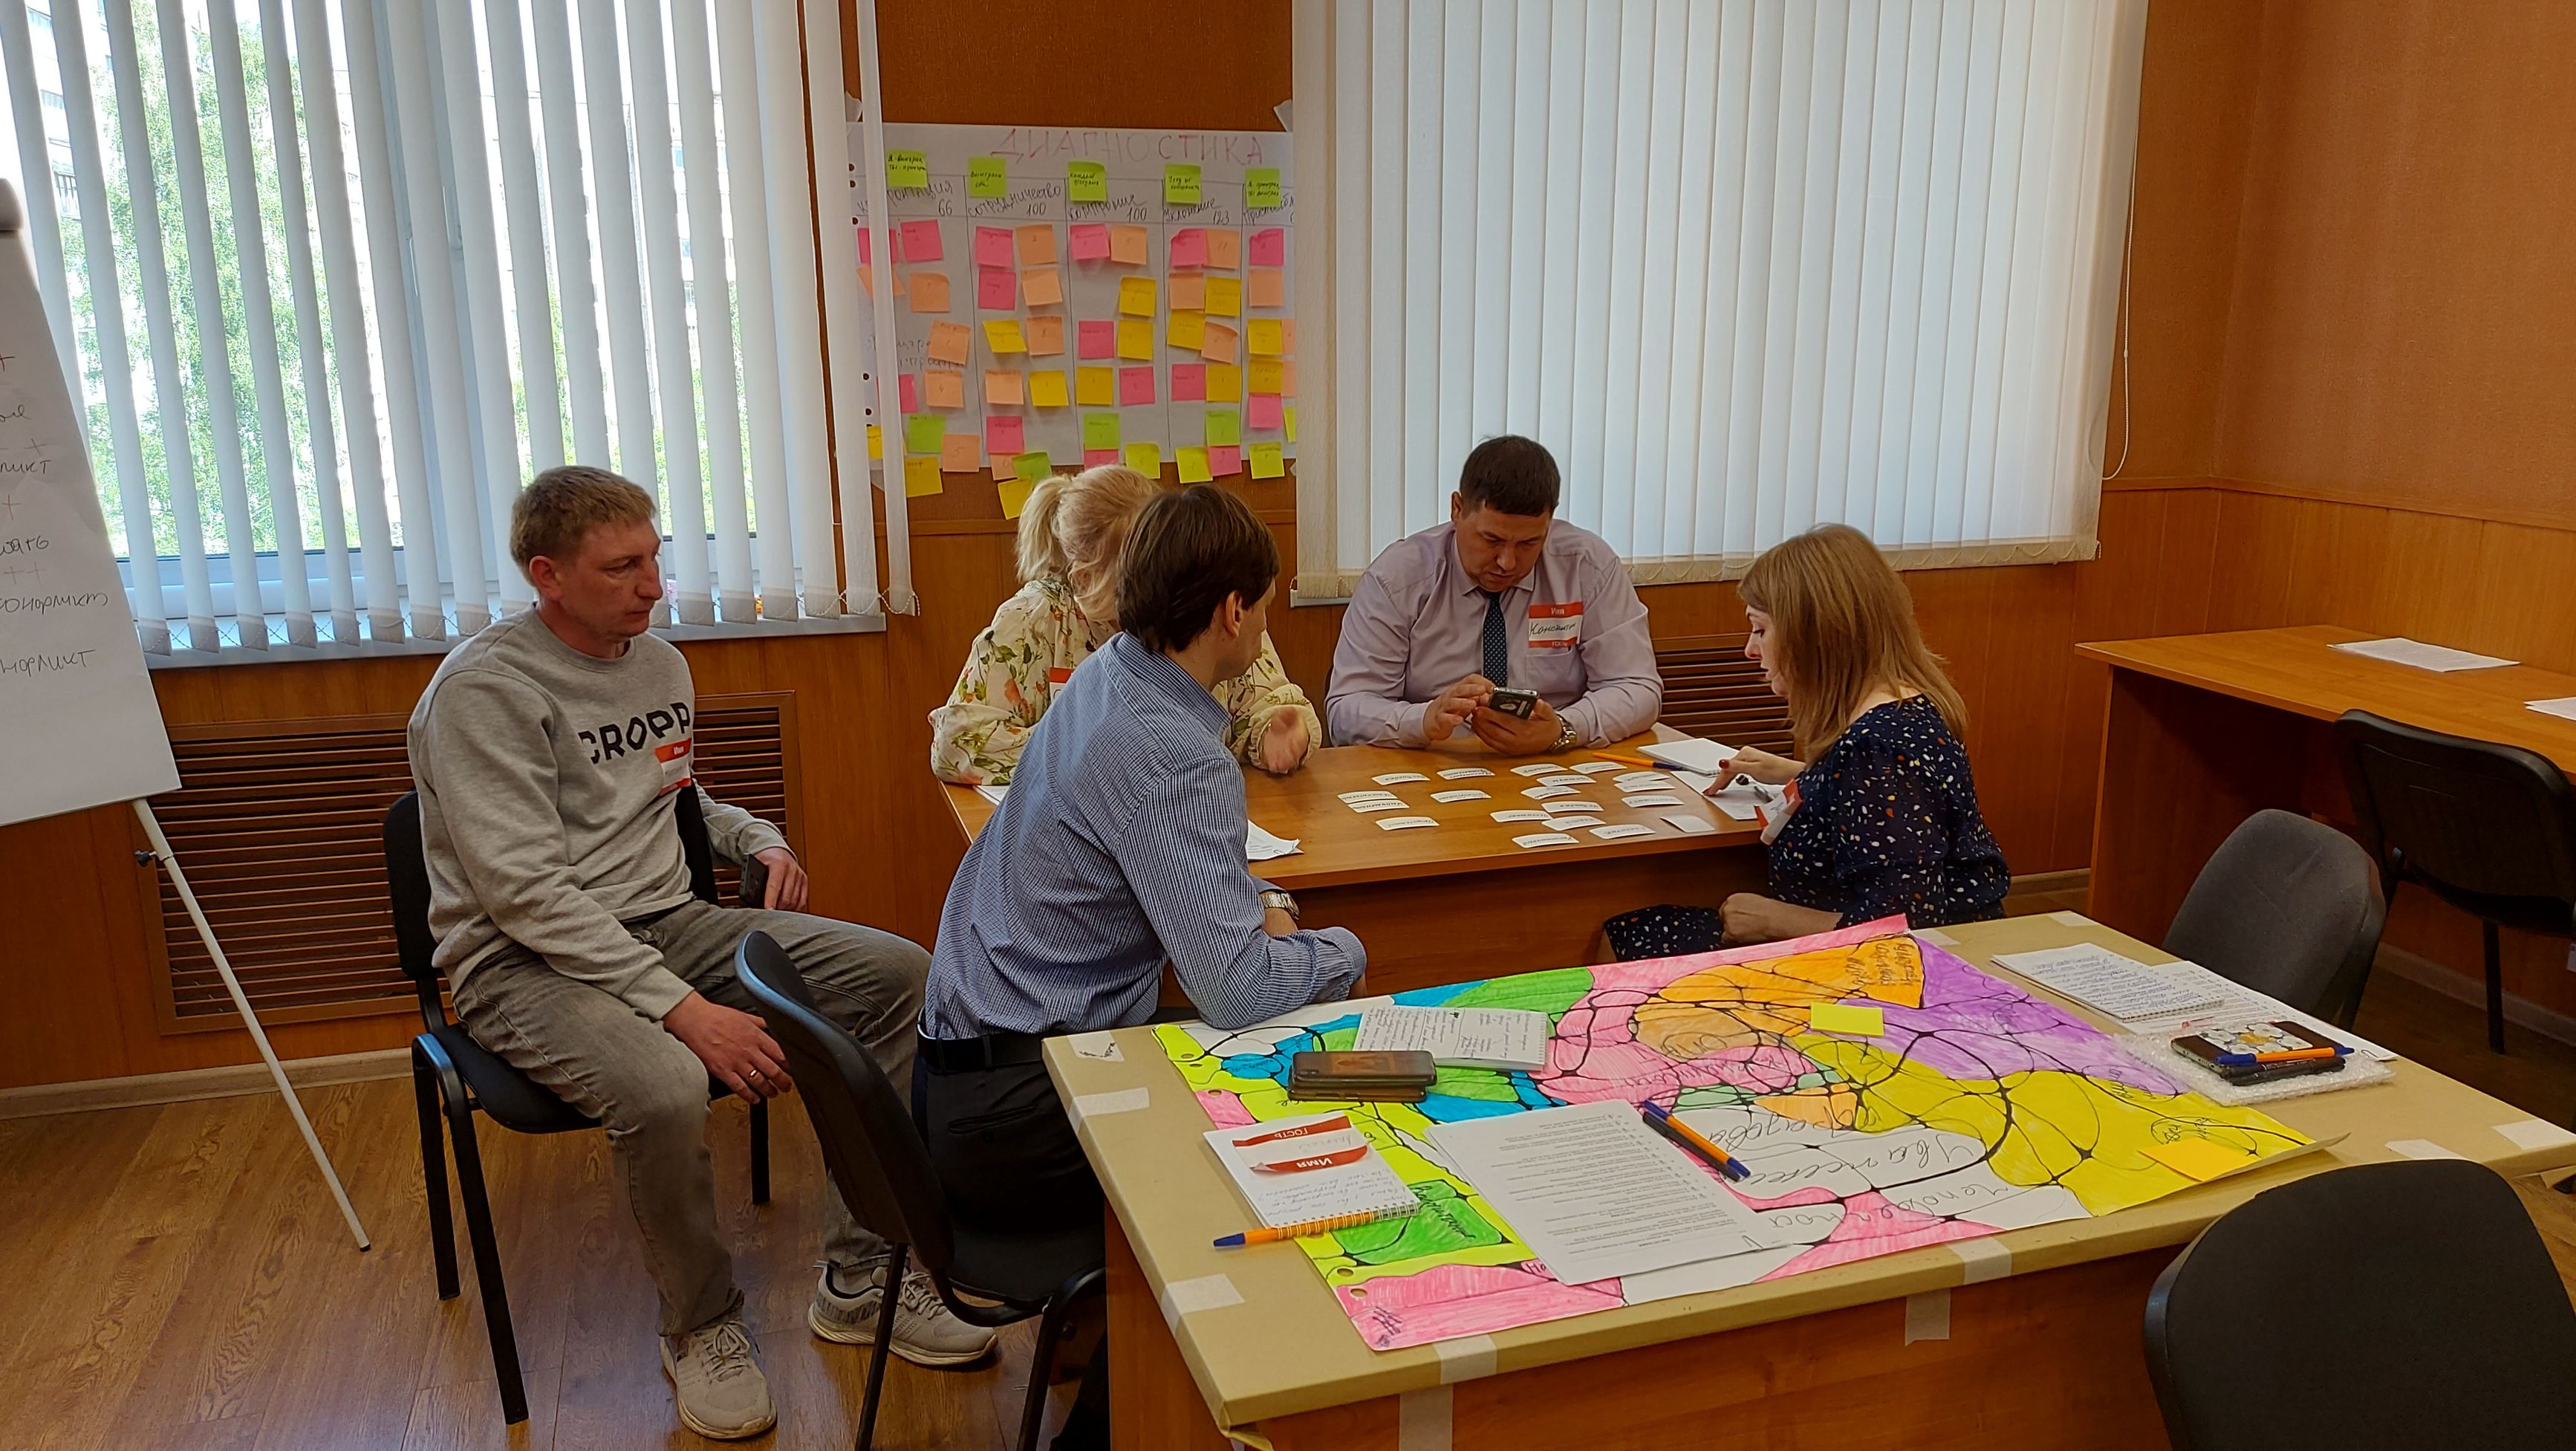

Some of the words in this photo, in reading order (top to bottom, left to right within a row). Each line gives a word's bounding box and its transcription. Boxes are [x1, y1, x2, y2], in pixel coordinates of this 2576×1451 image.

[991, 127, 1264, 165] ДИАГНОСТИКА
[938, 199, 952, 217] 66
[1027, 201, 1047, 217] 100
[1127, 207, 1147, 224] 100
[1212, 210, 1230, 226] 123
[578, 702, 691, 765] CROPP
[1274, 1127, 1309, 1139] ГОСТЬ
